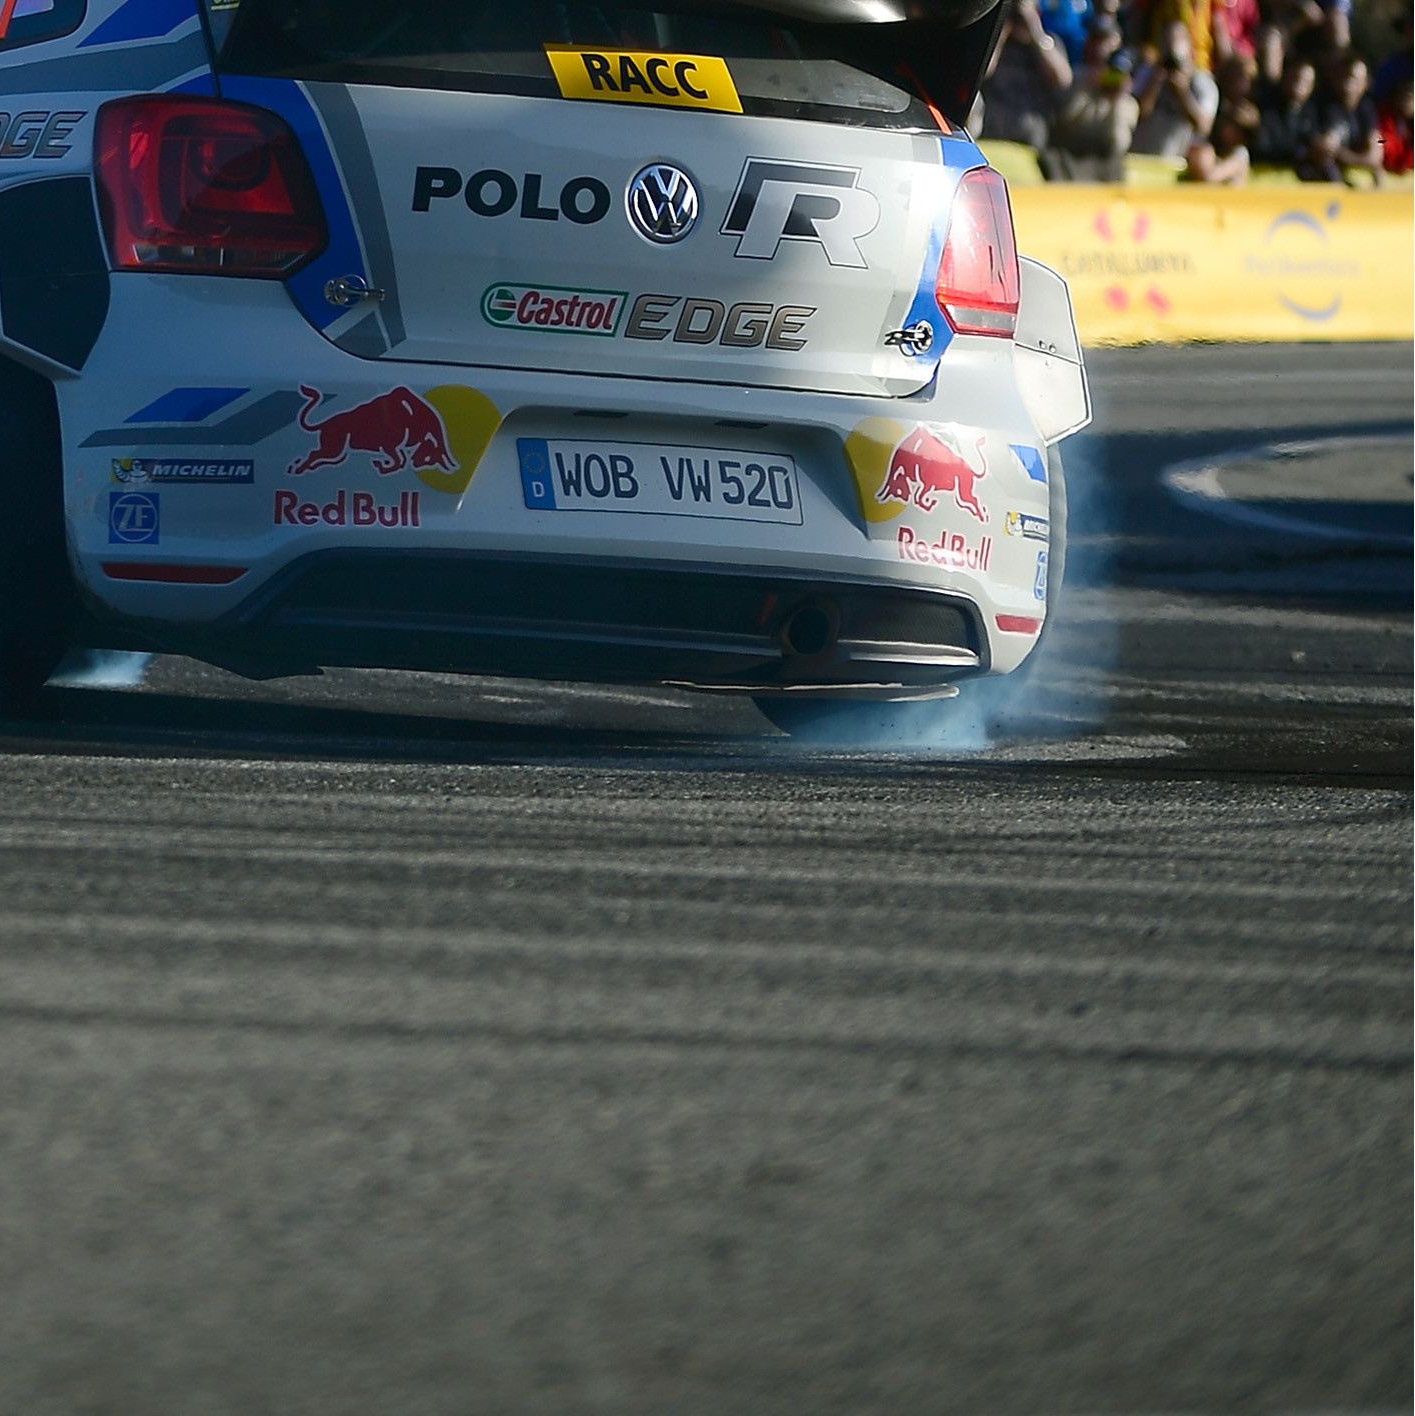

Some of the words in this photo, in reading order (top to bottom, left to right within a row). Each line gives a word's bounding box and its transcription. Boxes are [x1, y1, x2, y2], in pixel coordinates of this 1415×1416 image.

[580, 52, 710, 100] RACC
[411, 165, 612, 225] POLO
[725, 162, 882, 270] R
[516, 289, 618, 332] Castrol
[623, 293, 818, 352] EDGE
[151, 464, 252, 476] MICHELIN
[533, 480, 546, 499] D
[553, 452, 640, 500] WOB
[660, 456, 713, 505] VW
[720, 461, 795, 510] 520
[115, 504, 154, 532] ZF
[272, 490, 346, 527] Red
[352, 491, 421, 528] Bull
[896, 525, 948, 566] Red
[948, 530, 993, 572] Bull
